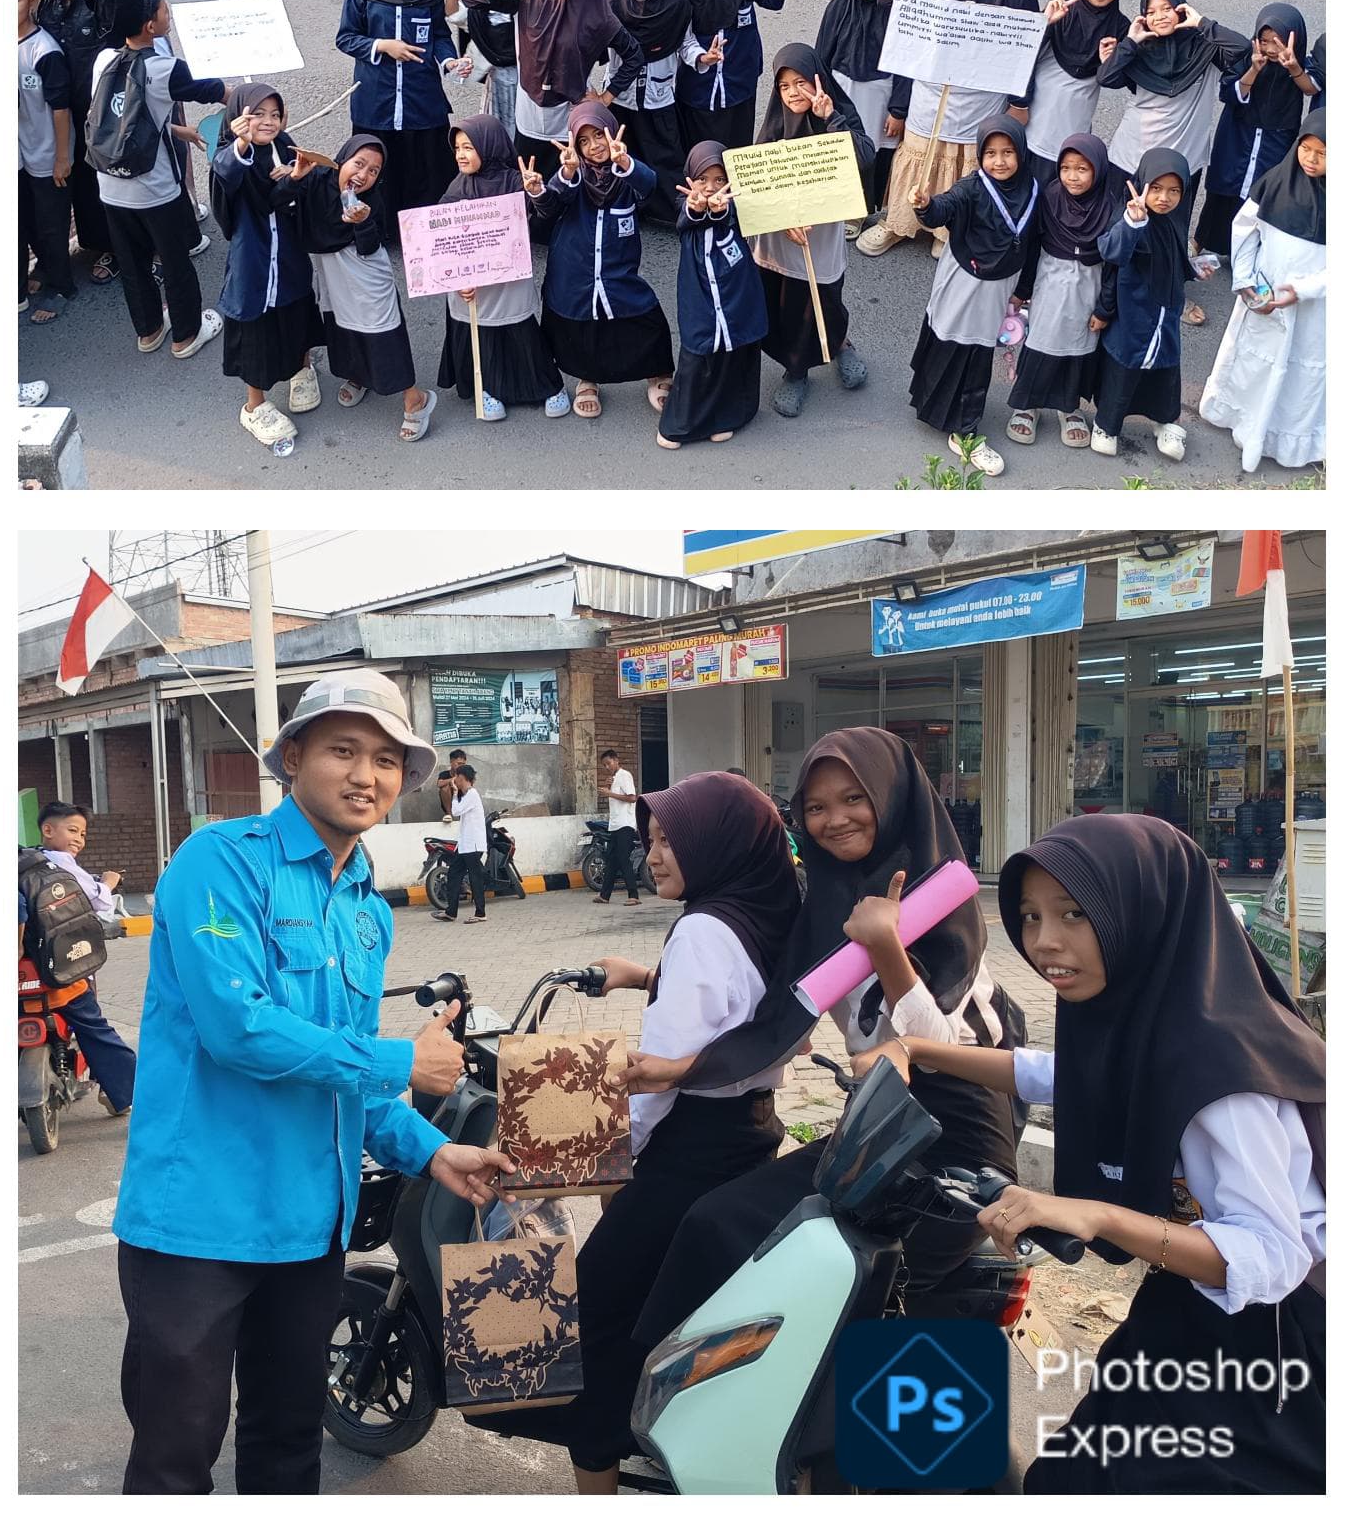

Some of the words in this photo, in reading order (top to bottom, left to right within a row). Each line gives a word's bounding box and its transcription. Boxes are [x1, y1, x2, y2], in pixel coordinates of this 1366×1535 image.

[1018, 591, 1043, 603] 23.00
[973, 612, 993, 622] anda
[630, 645, 656, 657] PROMO
[656, 637, 702, 653] INDOMARET
